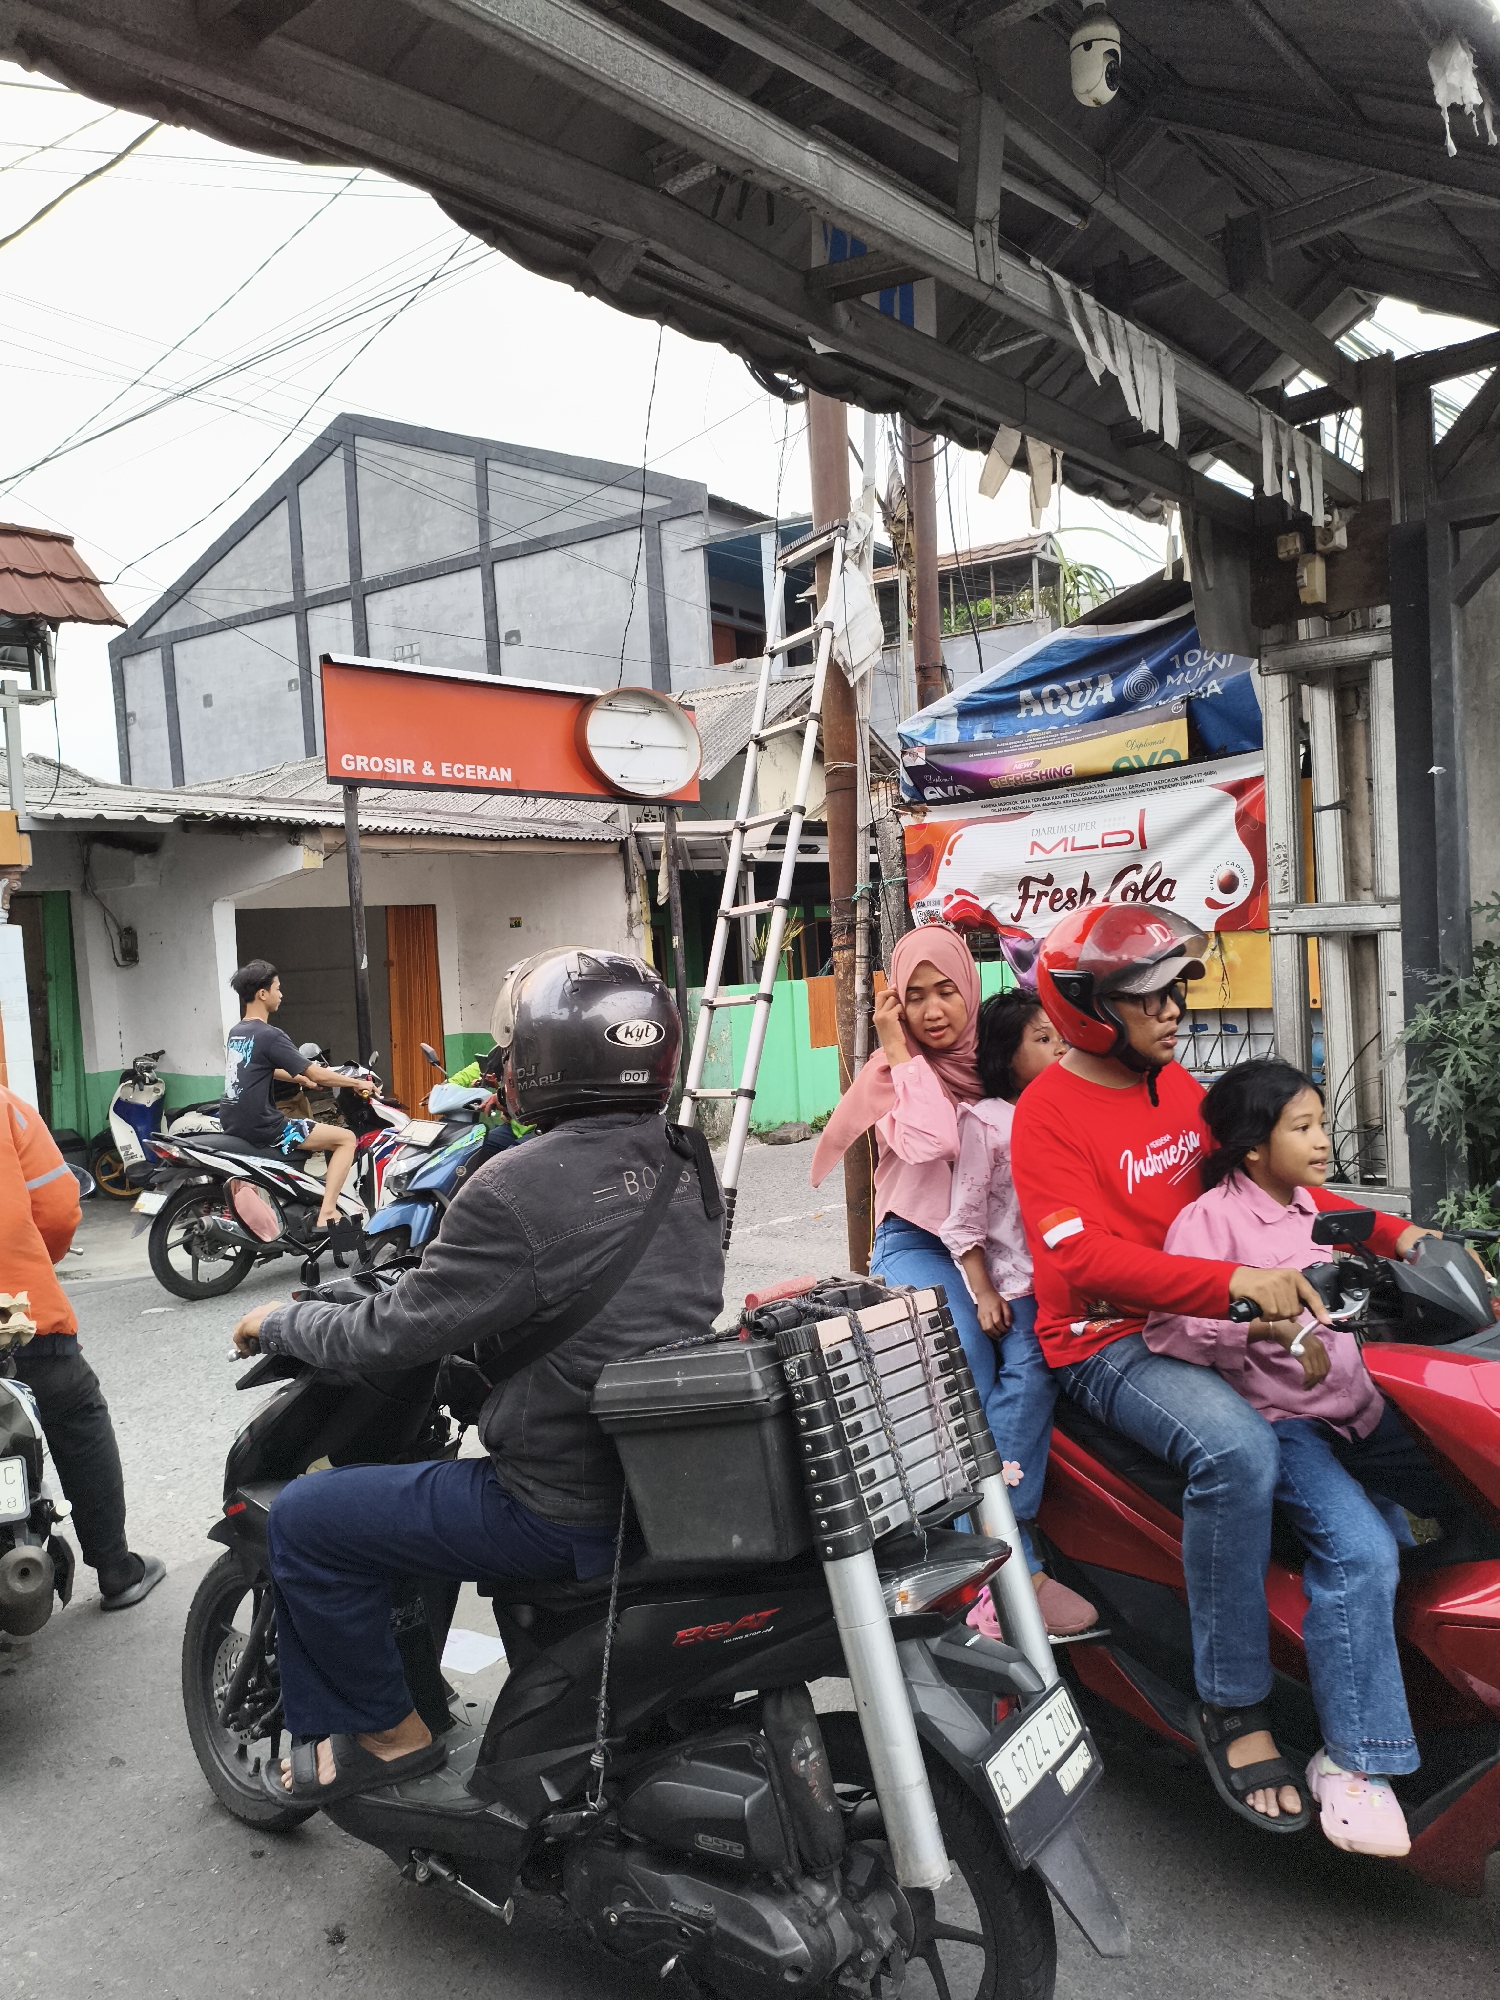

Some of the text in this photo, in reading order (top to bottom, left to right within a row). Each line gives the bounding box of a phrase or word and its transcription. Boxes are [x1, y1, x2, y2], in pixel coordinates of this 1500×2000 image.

[1017, 674, 1115, 717] AQUA
[1125, 737, 1166, 751] Diplomat
[341, 754, 512, 782] GROSIR & ECERAN
[989, 764, 1073, 789] REFRESHING
[1013, 761, 1034, 770] NEW!
[1031, 821, 1096, 837] DJARUM SUPER
[1010, 870, 1097, 922] Fresh
[1102, 861, 1177, 903] Cola
[624, 1072, 647, 1082] DOT
[1120, 1130, 1200, 1194] Indonesia
[992, 1770, 1012, 1806] B
[1046, 1698, 1077, 1747] ZUV
